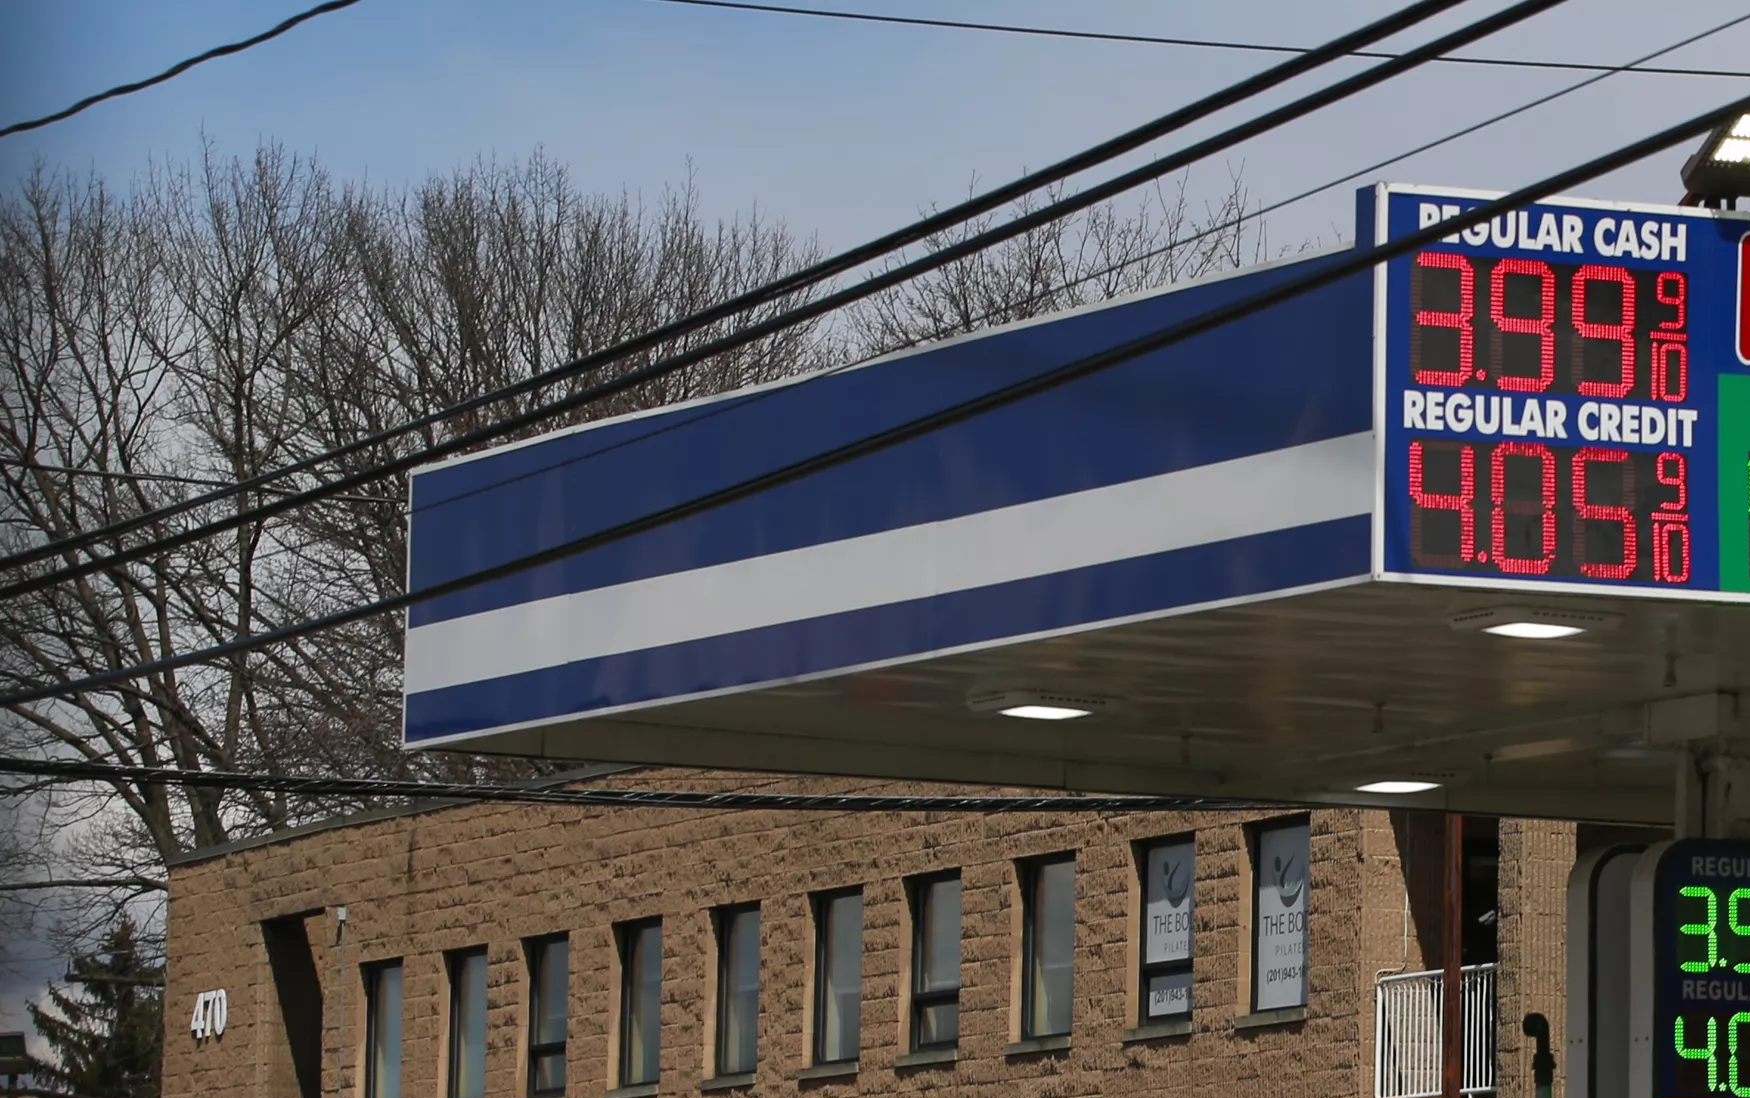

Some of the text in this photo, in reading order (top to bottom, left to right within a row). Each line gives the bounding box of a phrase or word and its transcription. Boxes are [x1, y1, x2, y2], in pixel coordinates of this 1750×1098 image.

[1418, 202, 1688, 263] REGULAR CASH
[1415, 251, 1636, 399] 3.99
[1403, 391, 1698, 447] REGULAR CREDIT
[1408, 441, 1637, 579] 4.05
[1153, 914, 1173, 935] THE
[1263, 913, 1285, 936] THE
[190, 988, 228, 1039] 470
